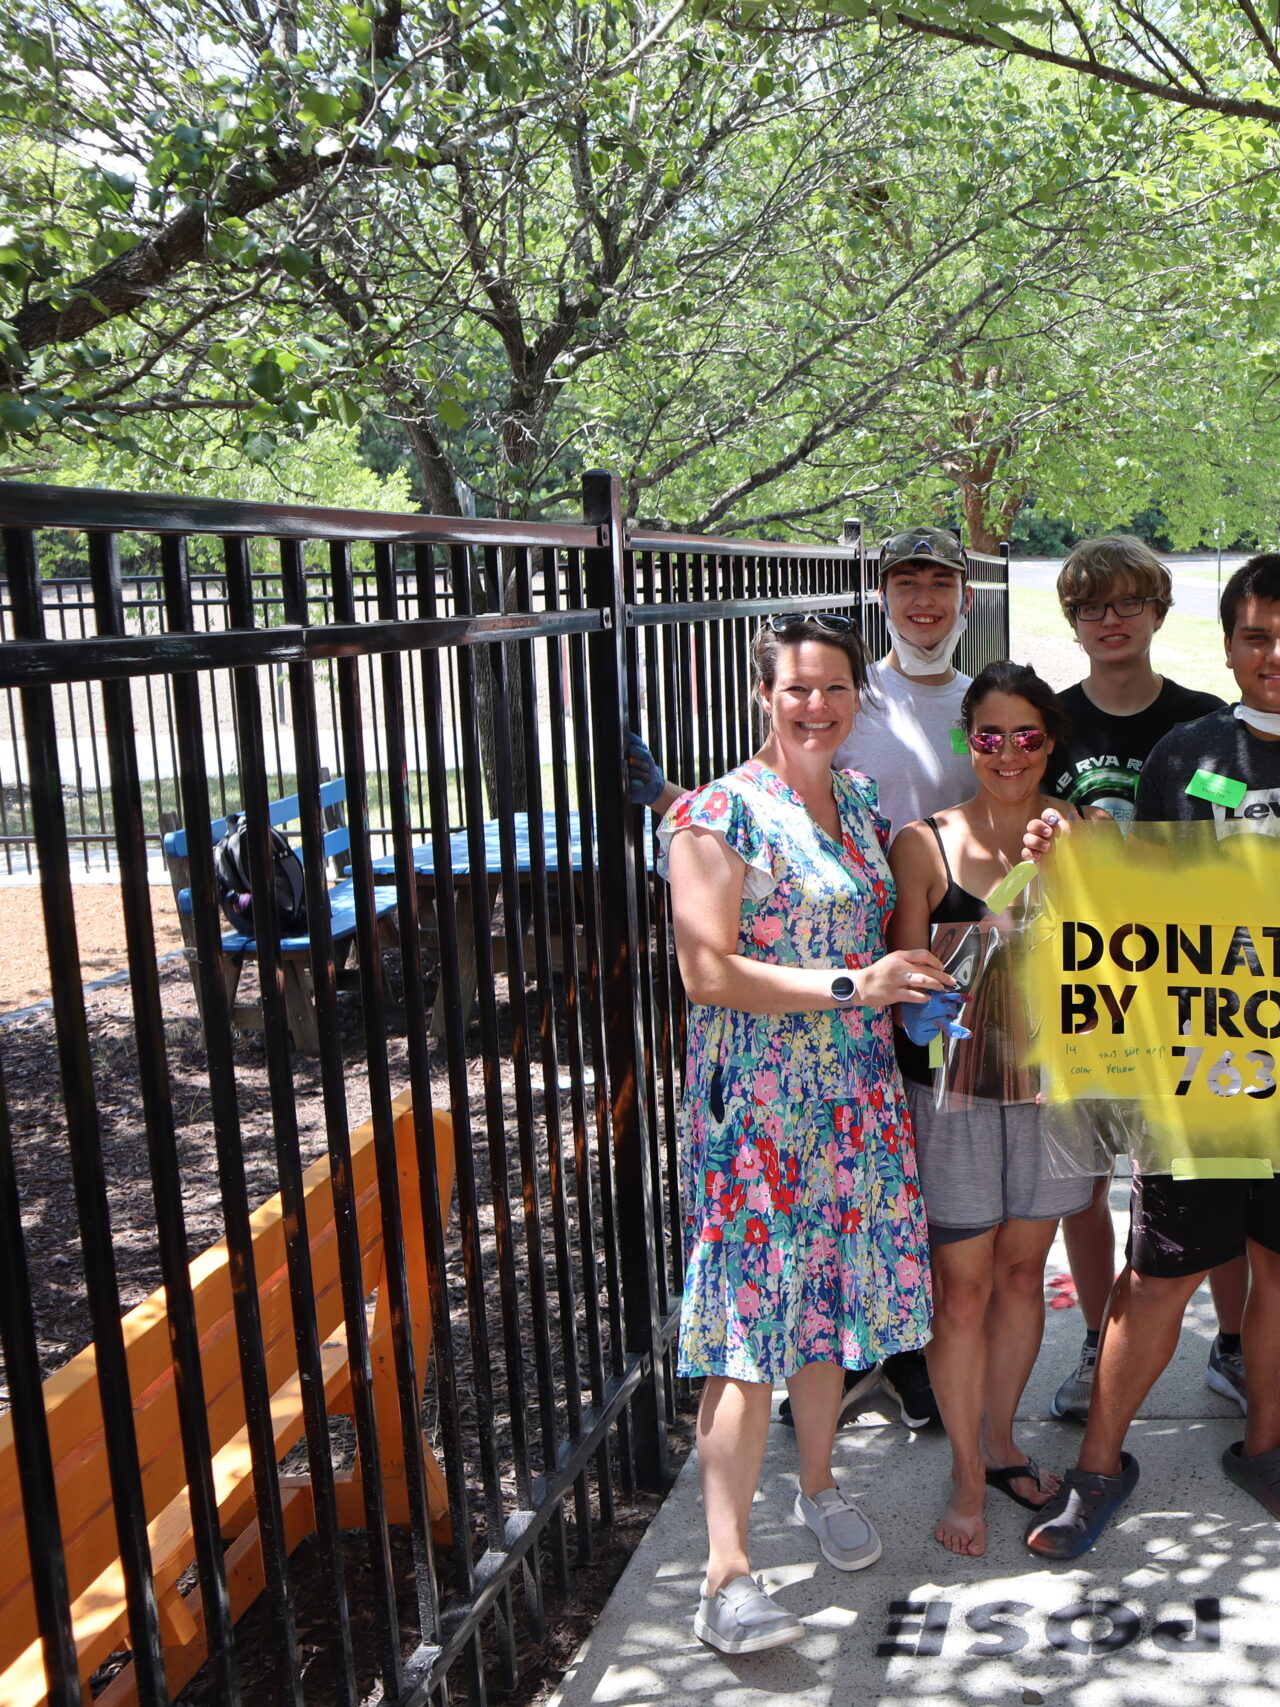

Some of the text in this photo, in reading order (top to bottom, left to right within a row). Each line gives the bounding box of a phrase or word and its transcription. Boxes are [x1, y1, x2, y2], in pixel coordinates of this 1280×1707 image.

[1075, 754, 1119, 774] RVA
[1061, 983, 1138, 1034] BY
[1171, 1045, 1278, 1099] 763
[876, 1599, 1221, 1657] POSE
